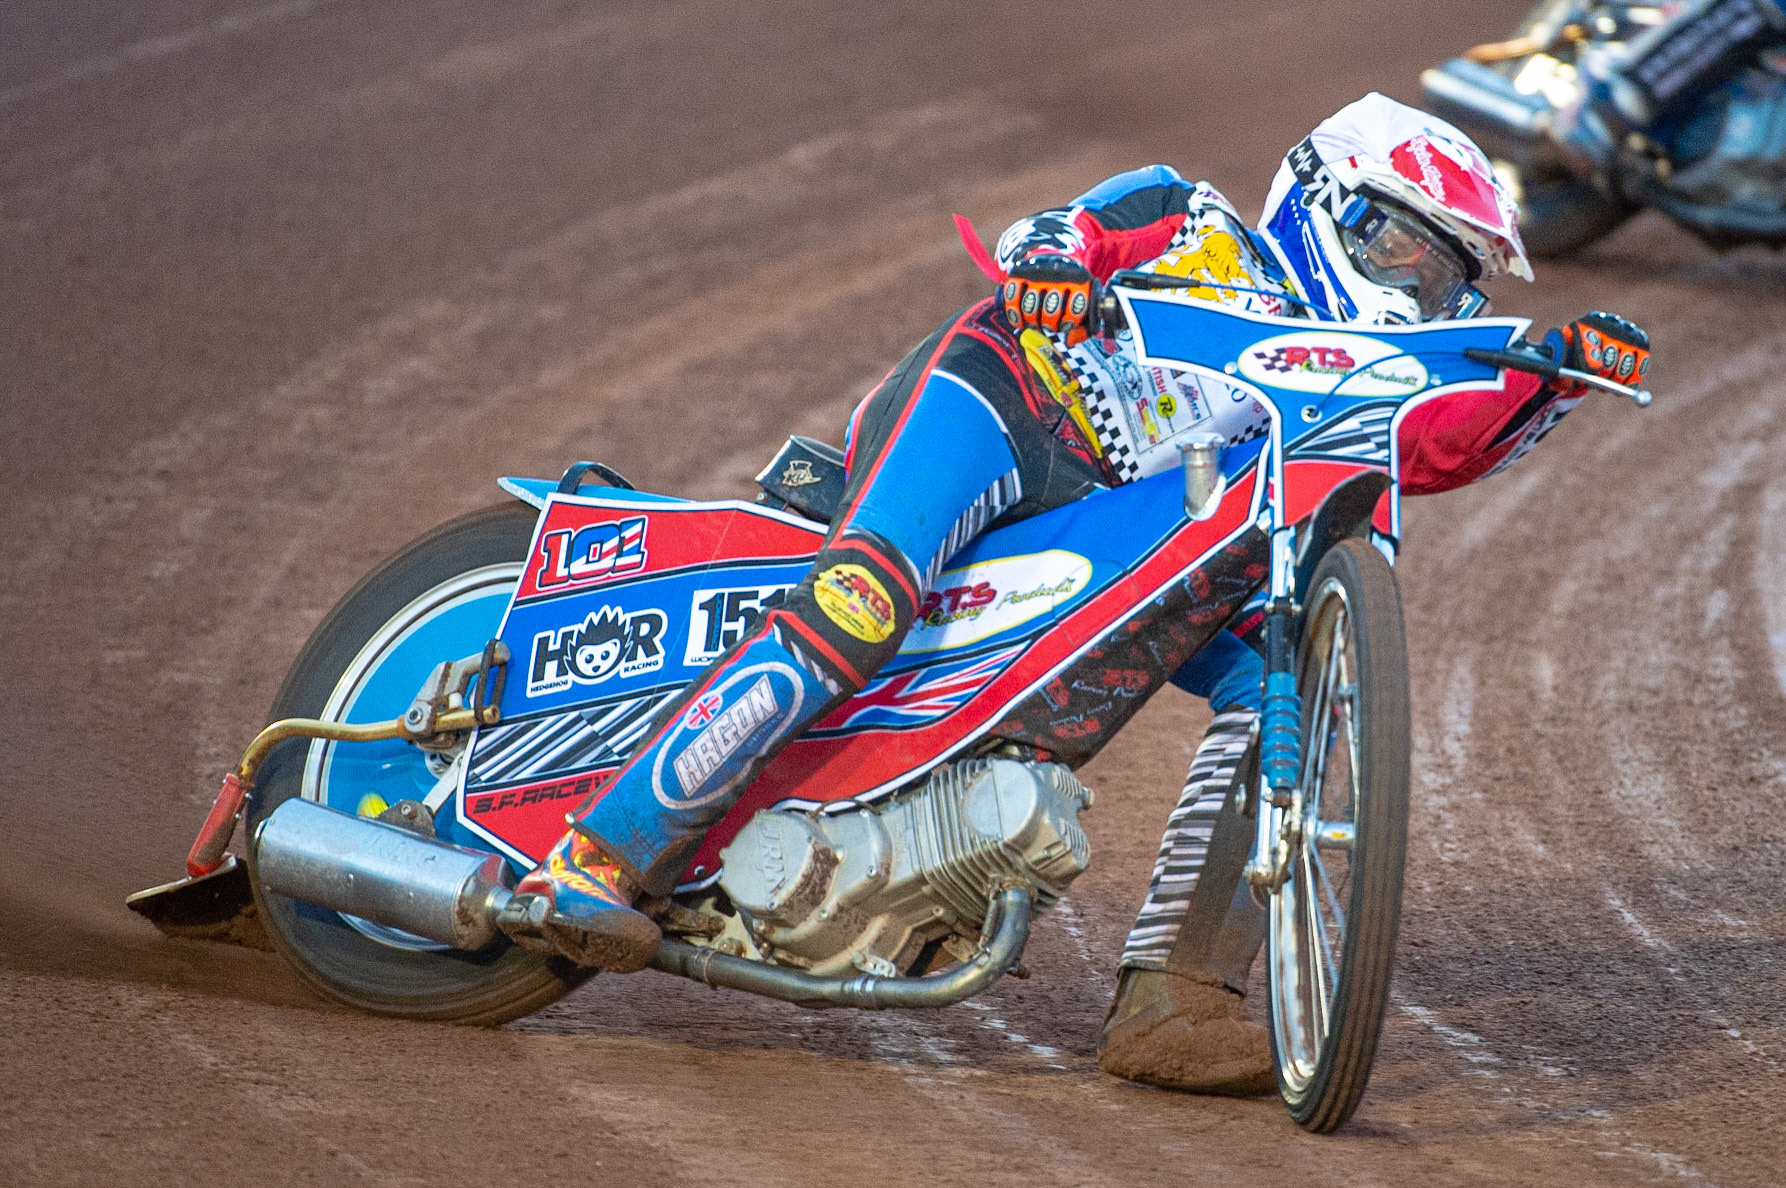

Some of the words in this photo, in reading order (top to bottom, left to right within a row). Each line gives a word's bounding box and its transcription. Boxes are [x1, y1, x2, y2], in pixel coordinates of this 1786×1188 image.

[1285, 346, 1355, 369] RTS
[539, 516, 648, 589] 101
[917, 581, 997, 617] RTS
[921, 607, 986, 631] Racing
[623, 659, 660, 674] RACING
[530, 679, 569, 693] HEDGEHOG
[673, 673, 779, 799] HAGON
